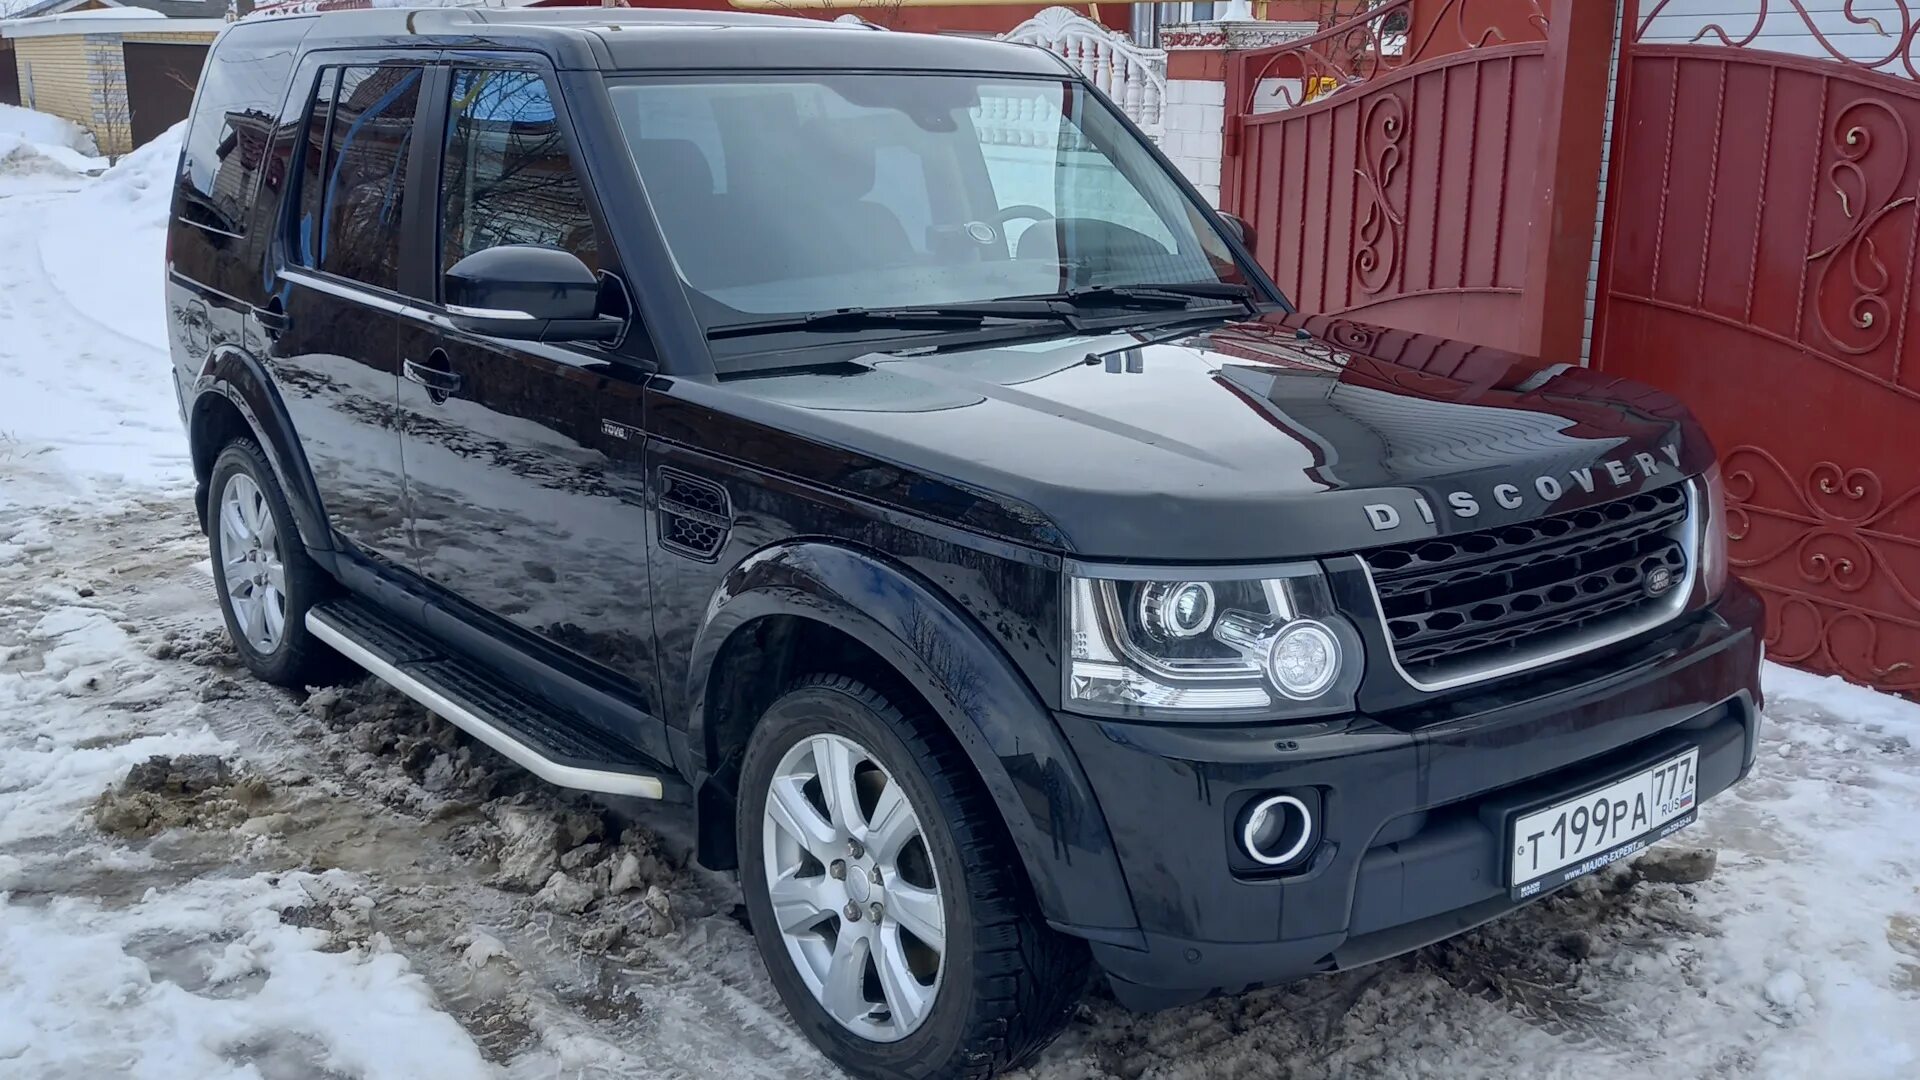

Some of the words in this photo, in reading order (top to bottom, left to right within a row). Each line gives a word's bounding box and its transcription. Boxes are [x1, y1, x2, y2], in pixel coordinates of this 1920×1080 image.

[1363, 444, 1681, 532] DISCOVERY
[1527, 792, 1647, 870] T199PA
[1654, 757, 1692, 806] 777
[1661, 797, 1680, 817] RUS
